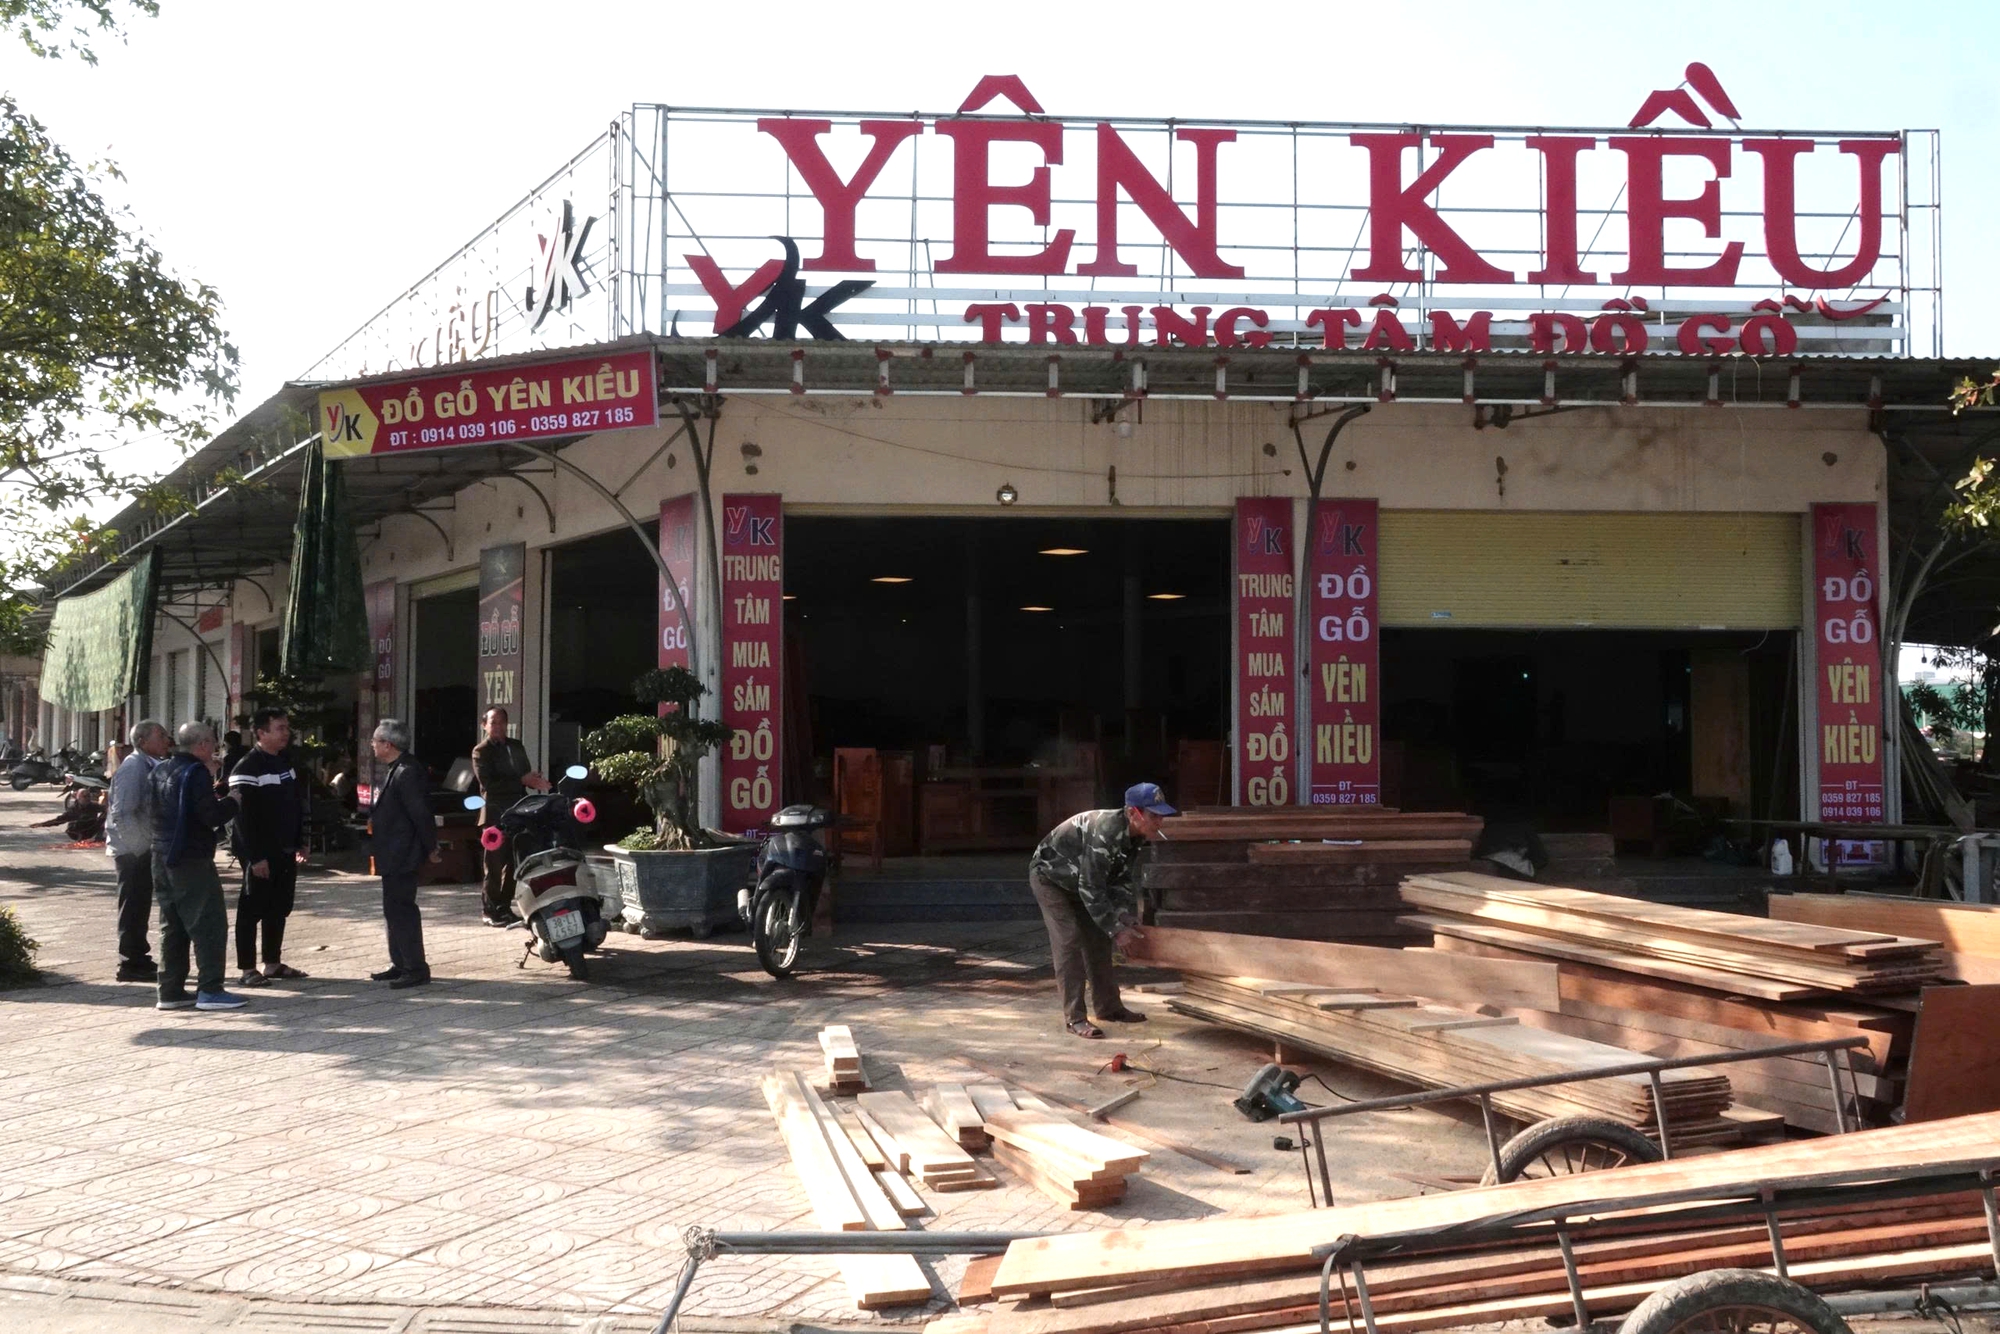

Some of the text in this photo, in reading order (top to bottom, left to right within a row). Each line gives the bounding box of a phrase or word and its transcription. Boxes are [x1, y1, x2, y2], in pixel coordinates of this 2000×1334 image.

[757, 61, 1901, 288] YÊN KIỀU
[964, 294, 1813, 356] TRUNG TÂM ĐỒ GỖ
[381, 364, 640, 425] ĐỒ GỖ YÊN KIỀU
[390, 431, 408, 447] ĐT
[420, 426, 455, 442] 0914
[459, 423, 485, 439] 039
[489, 420, 516, 436] 106
[530, 414, 568, 431] 0359
[572, 410, 599, 427] 827
[605, 407, 634, 424] 185
[726, 506, 776, 546] YK
[724, 555, 780, 582] TRUNG
[1239, 573, 1293, 598] TRUNG
[1318, 565, 1371, 599] ĐỒ
[1822, 568, 1872, 602] ĐỒ
[734, 592, 770, 625] TÂM
[1249, 608, 1283, 637] TÂM
[1319, 606, 1370, 641] GỖ
[1824, 610, 1872, 644] GỖ
[732, 641, 771, 669] MUA
[1248, 653, 1284, 677] MUA
[484, 665, 514, 705] YÊN
[733, 675, 770, 712] SẮM
[1321, 655, 1366, 703] YÊN
[1828, 657, 1870, 704] YÊN
[1249, 684, 1284, 717] SẮM
[730, 717, 774, 761] ĐỒ
[1246, 722, 1288, 762] ĐỒ
[1316, 709, 1372, 764] KIỀU
[1824, 710, 1876, 765] KIỀU
[730, 765, 772, 810] GỖ
[1248, 765, 1288, 806] GỖ
[1313, 793, 1376, 804] 0359 827 185
[1339, 781, 1351, 791] ĐT
[1822, 793, 1880, 803] 0359 827 185
[1845, 781, 1858, 790] ĐT
[1822, 807, 1881, 817] 0914 039 106
